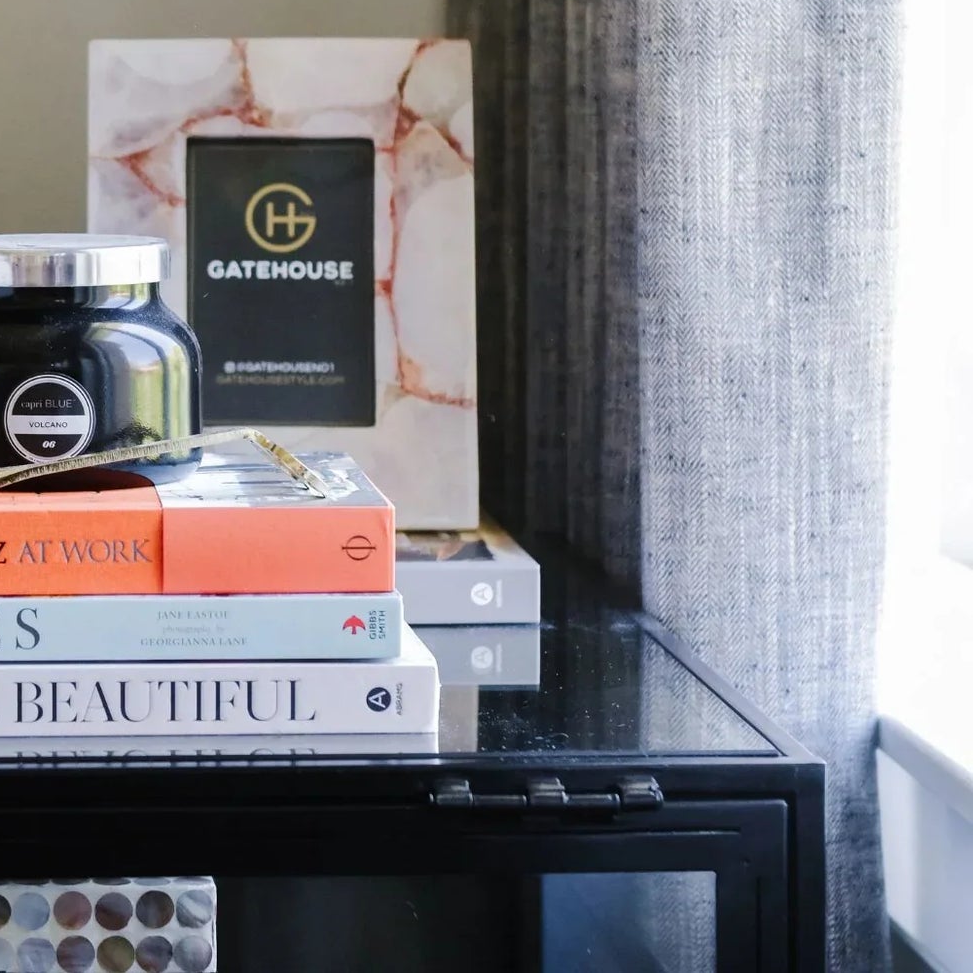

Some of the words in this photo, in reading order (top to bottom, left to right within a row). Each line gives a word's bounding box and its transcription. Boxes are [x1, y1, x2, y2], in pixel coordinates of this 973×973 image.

[207, 259, 354, 280] GATEHOUSE
[21, 400, 43, 410] capri
[45, 399, 73, 408] BLUE
[42, 440, 57, 449] 06
[18, 538, 53, 564] AT
[60, 537, 154, 563] WORK
[158, 610, 182, 621] JANE
[369, 610, 377, 639] GIBBS
[379, 610, 387, 639] SMITH
[140, 637, 216, 647] GEORGIANNA
[219, 637, 248, 646] LANE
[14, 679, 317, 724] BEAUTIFUL
